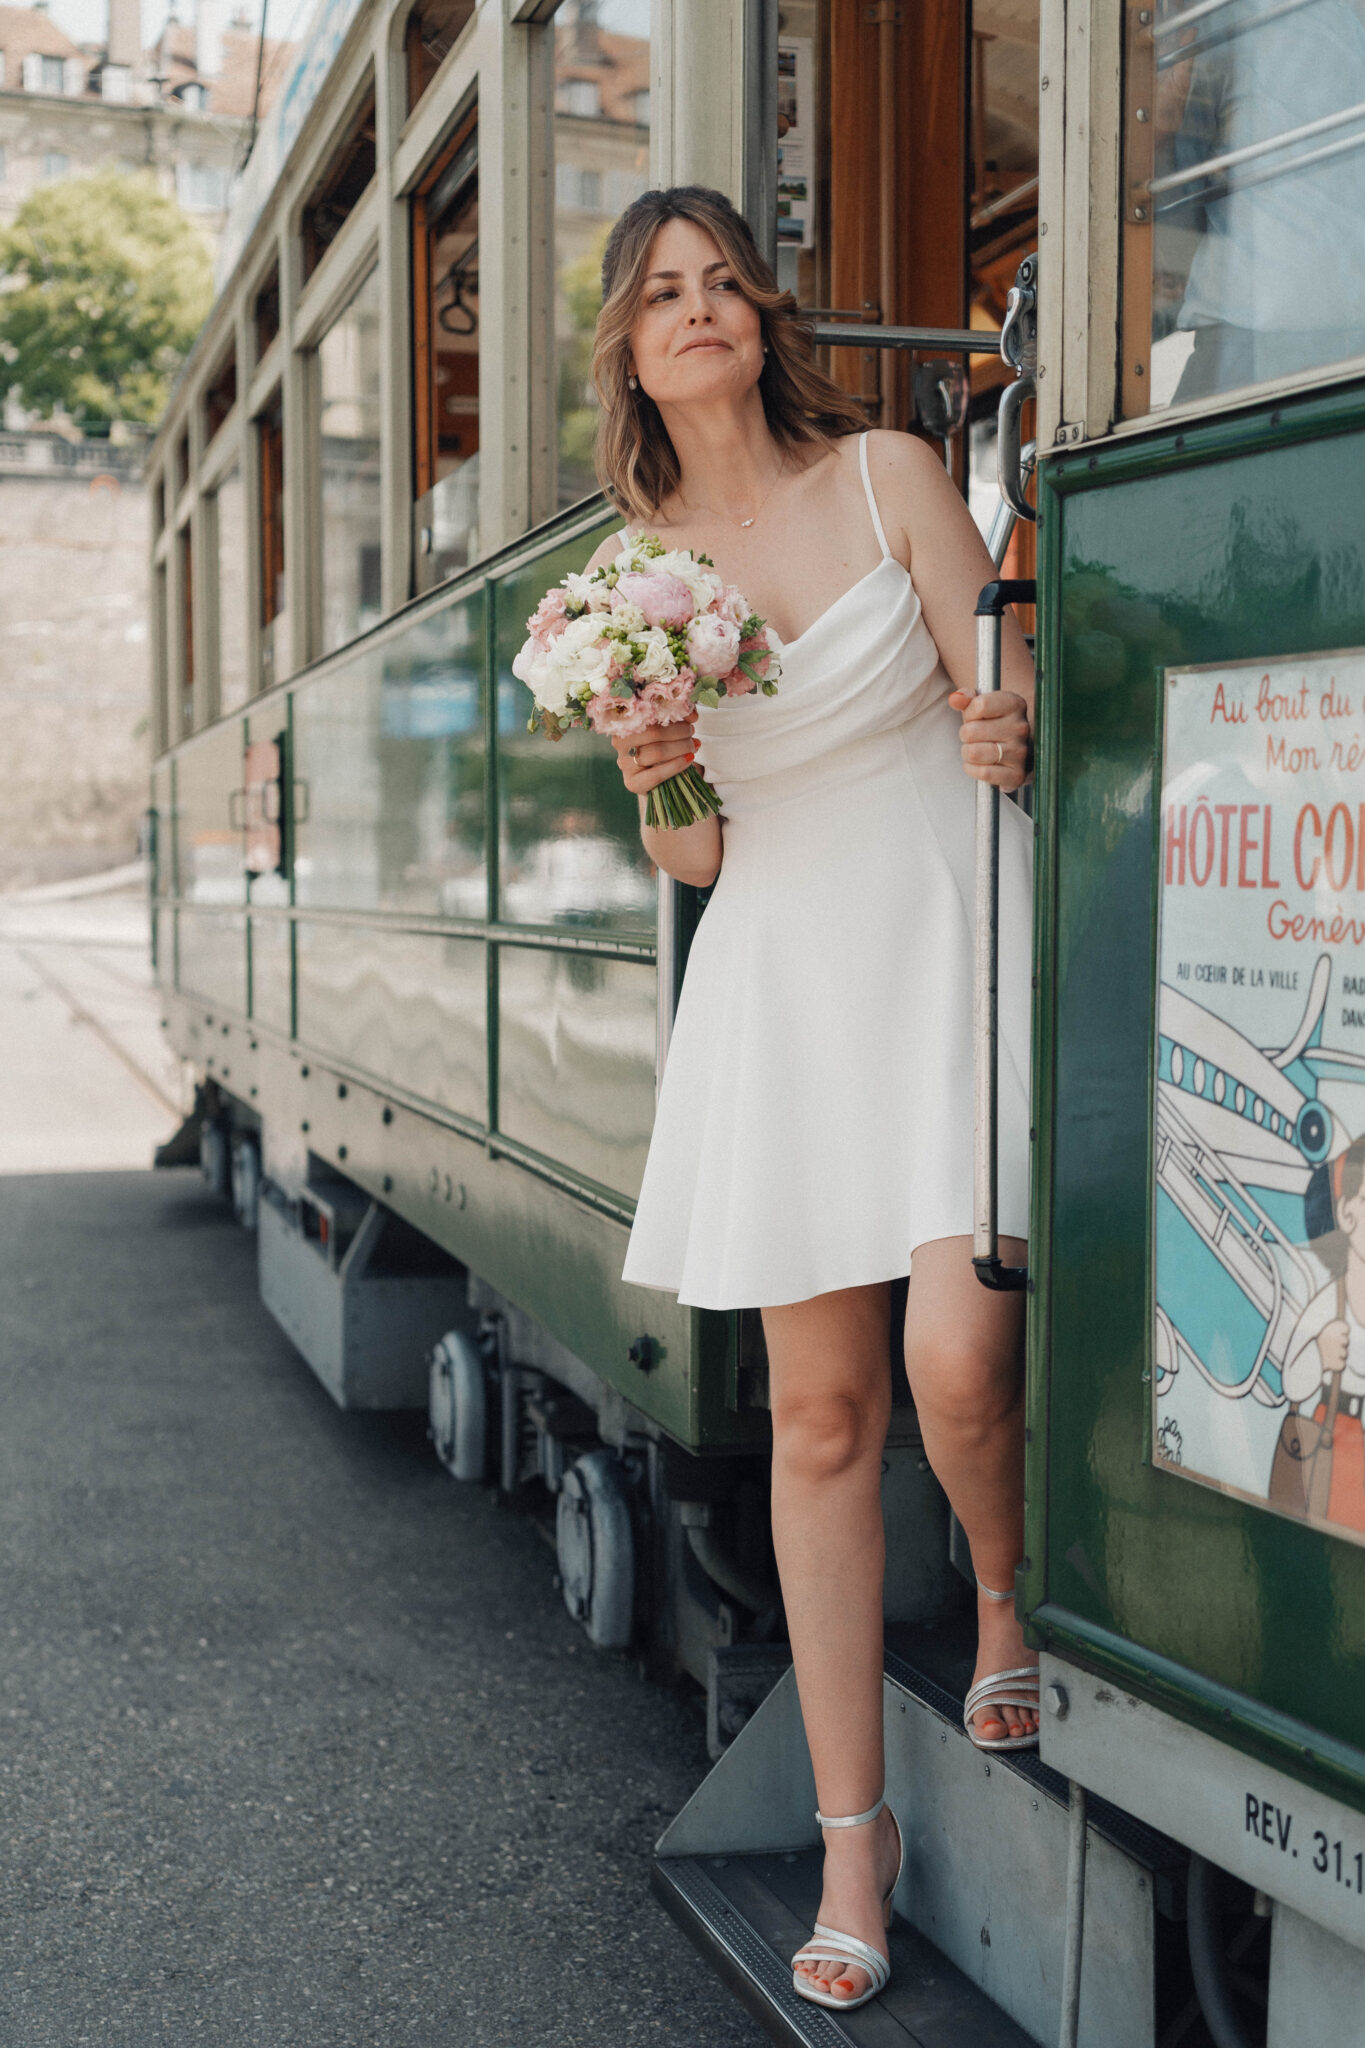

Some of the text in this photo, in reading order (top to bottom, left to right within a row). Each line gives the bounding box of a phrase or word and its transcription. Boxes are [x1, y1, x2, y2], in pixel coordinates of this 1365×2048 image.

[1210, 682, 1249, 724] Au
[1255, 673, 1311, 722] bout
[1320, 675, 1353, 720] du
[1266, 732, 1365, 774] Mon rê
[1165, 794, 1281, 889] HÔTEL
[1176, 962, 1190, 981] AU
[1232, 966, 1246, 986] DE
[1251, 968, 1264, 988] LA
[1269, 970, 1299, 991] VILLE
[1245, 1792, 1363, 1895] REV. 31.1
